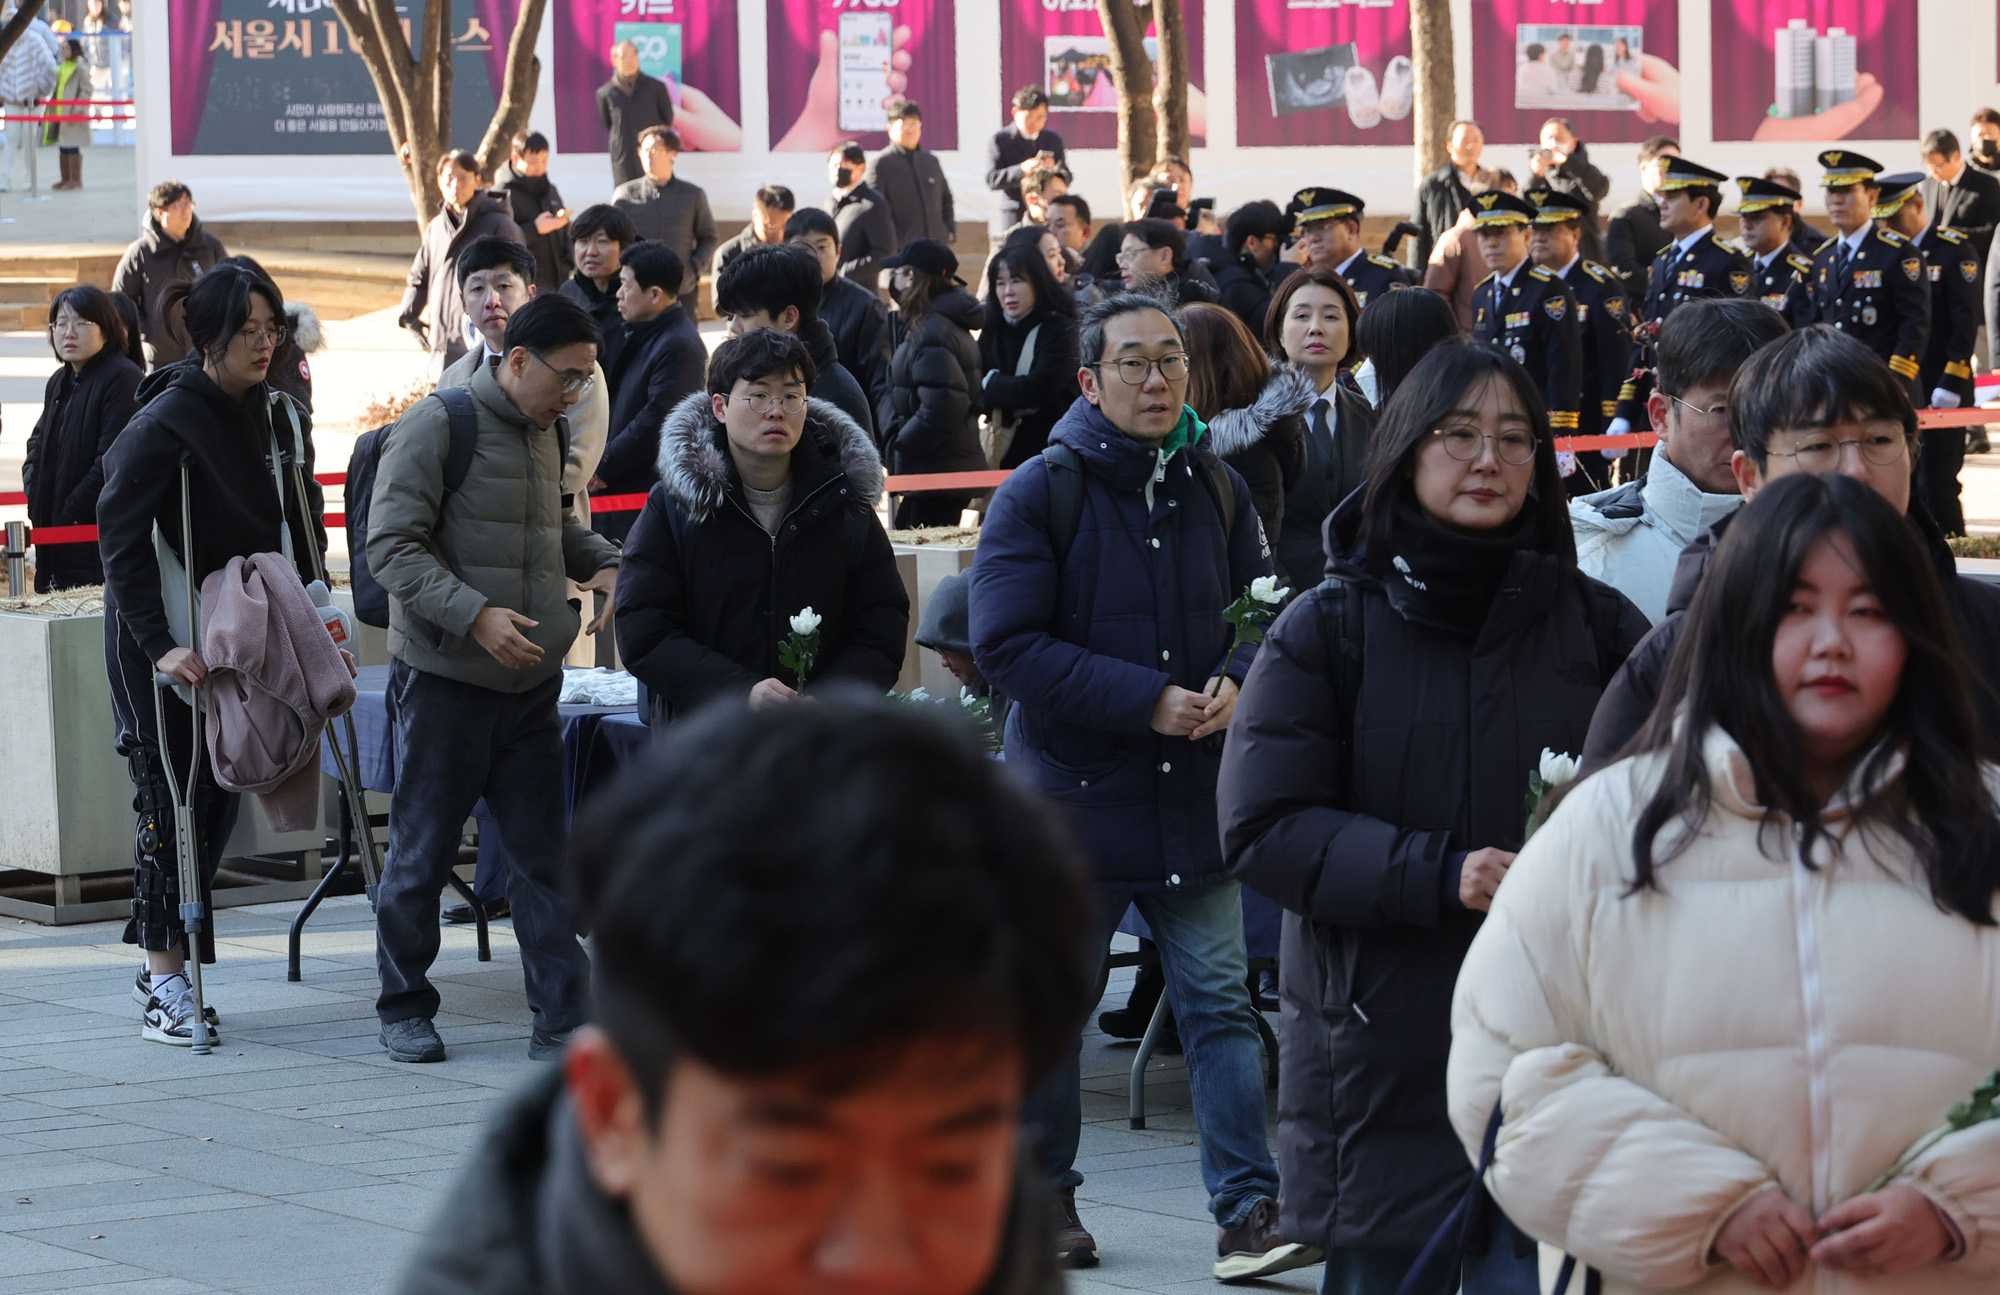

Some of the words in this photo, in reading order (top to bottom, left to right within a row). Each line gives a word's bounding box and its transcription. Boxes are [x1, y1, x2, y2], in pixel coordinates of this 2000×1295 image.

[208, 19, 312, 59] 서울시
[285, 103, 315, 117] 시민이
[316, 103, 365, 117] 사랑해주신
[274, 119, 285, 132] 더
[308, 119, 338, 132] 서울을
